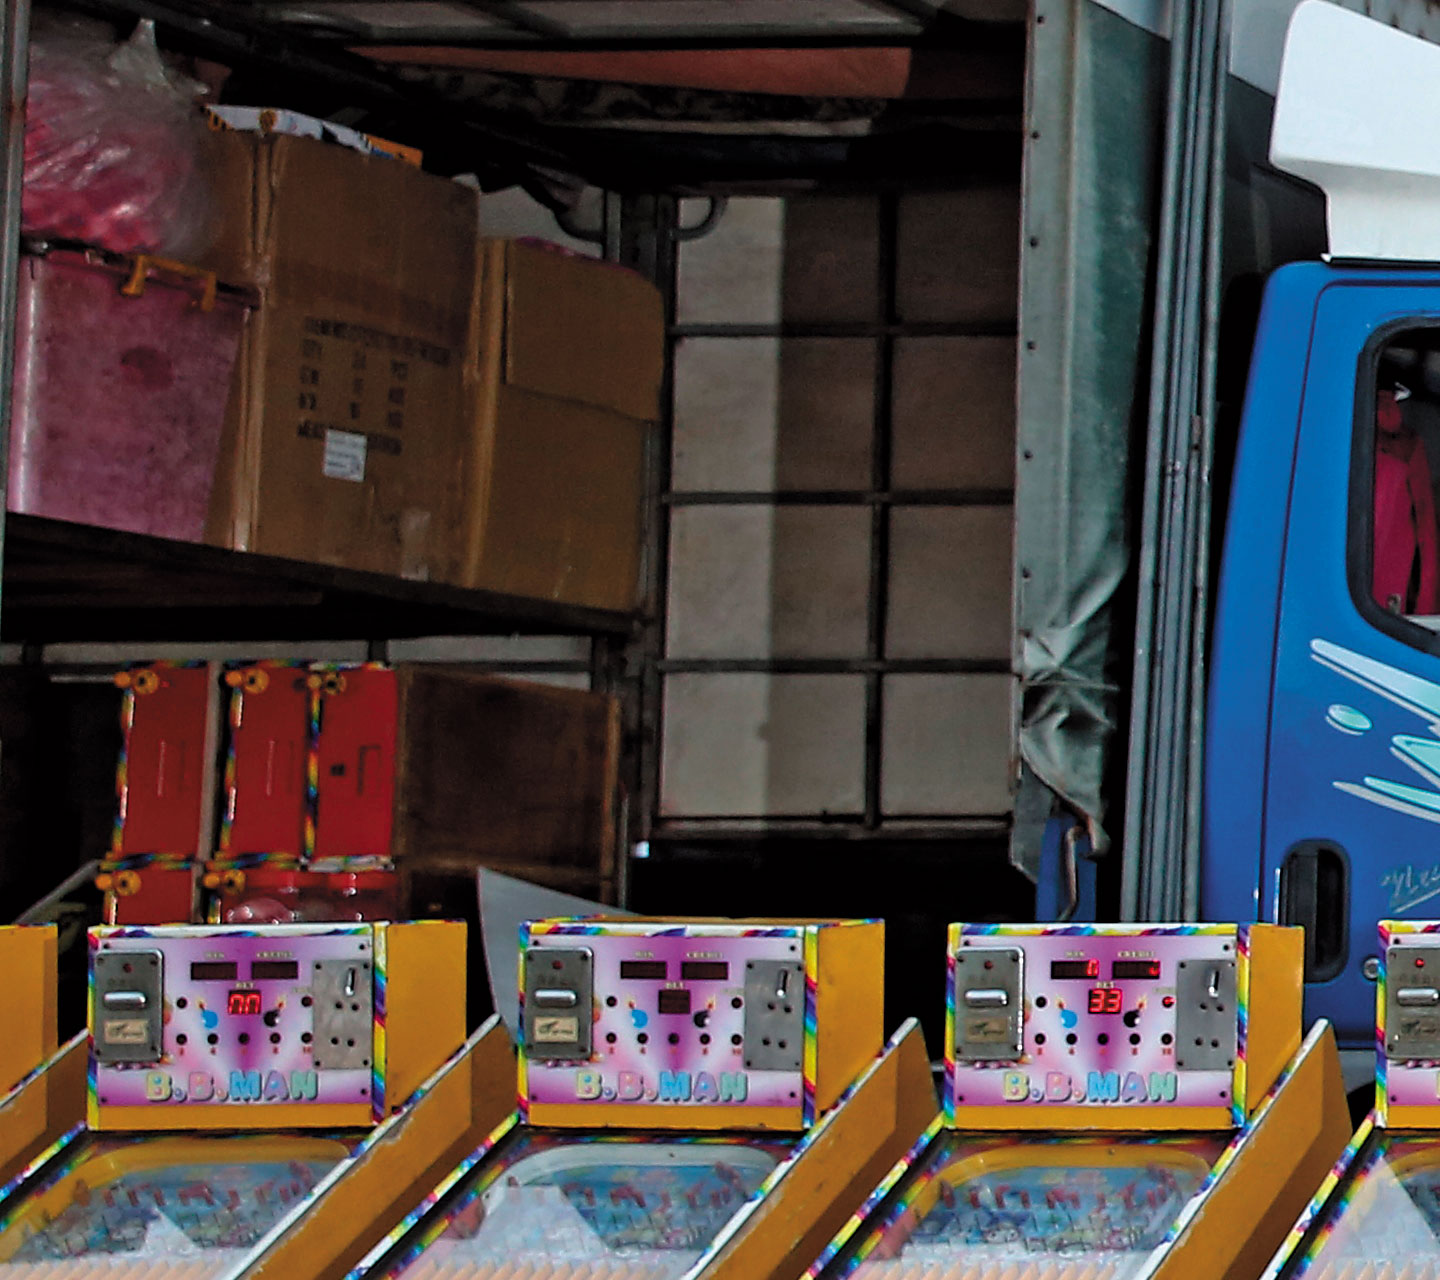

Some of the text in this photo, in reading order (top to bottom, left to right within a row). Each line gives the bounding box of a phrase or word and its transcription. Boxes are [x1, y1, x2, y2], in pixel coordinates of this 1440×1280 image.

[1090, 990, 1121, 1013] 33
[145, 1070, 318, 1102] B.B.MAN
[576, 1070, 748, 1102] B.B.MAN
[1002, 1071, 1178, 1103] B.B.MAN
